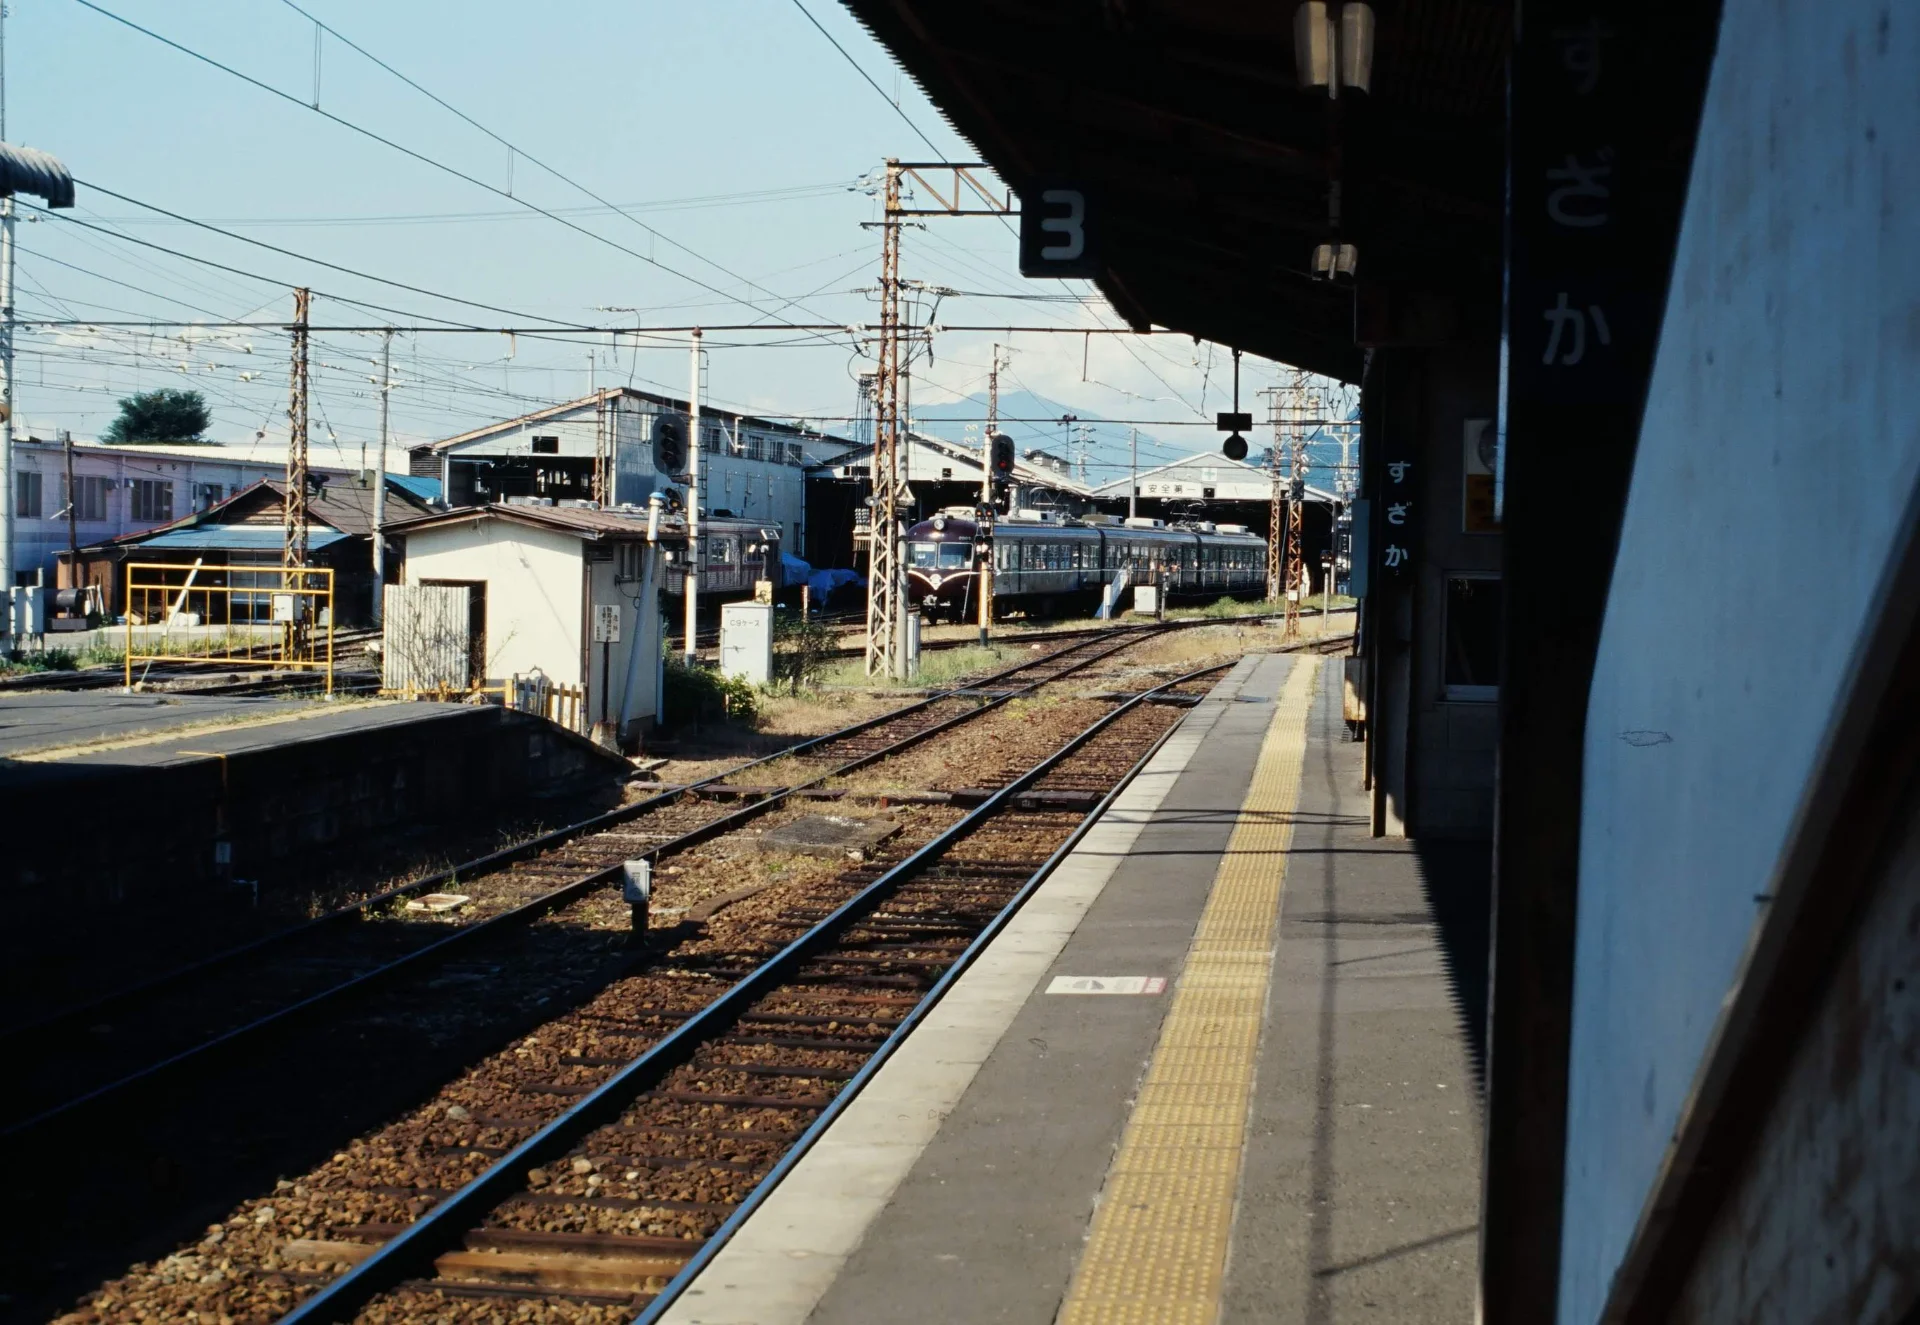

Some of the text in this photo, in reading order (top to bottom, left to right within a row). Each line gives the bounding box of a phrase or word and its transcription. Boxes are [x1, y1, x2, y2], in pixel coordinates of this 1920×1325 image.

[1040, 189, 1085, 261] 3
[1542, 17, 1616, 366] すざか
[1147, 484, 1197, 494] 安全第一
[1384, 460, 1413, 567] すざか
